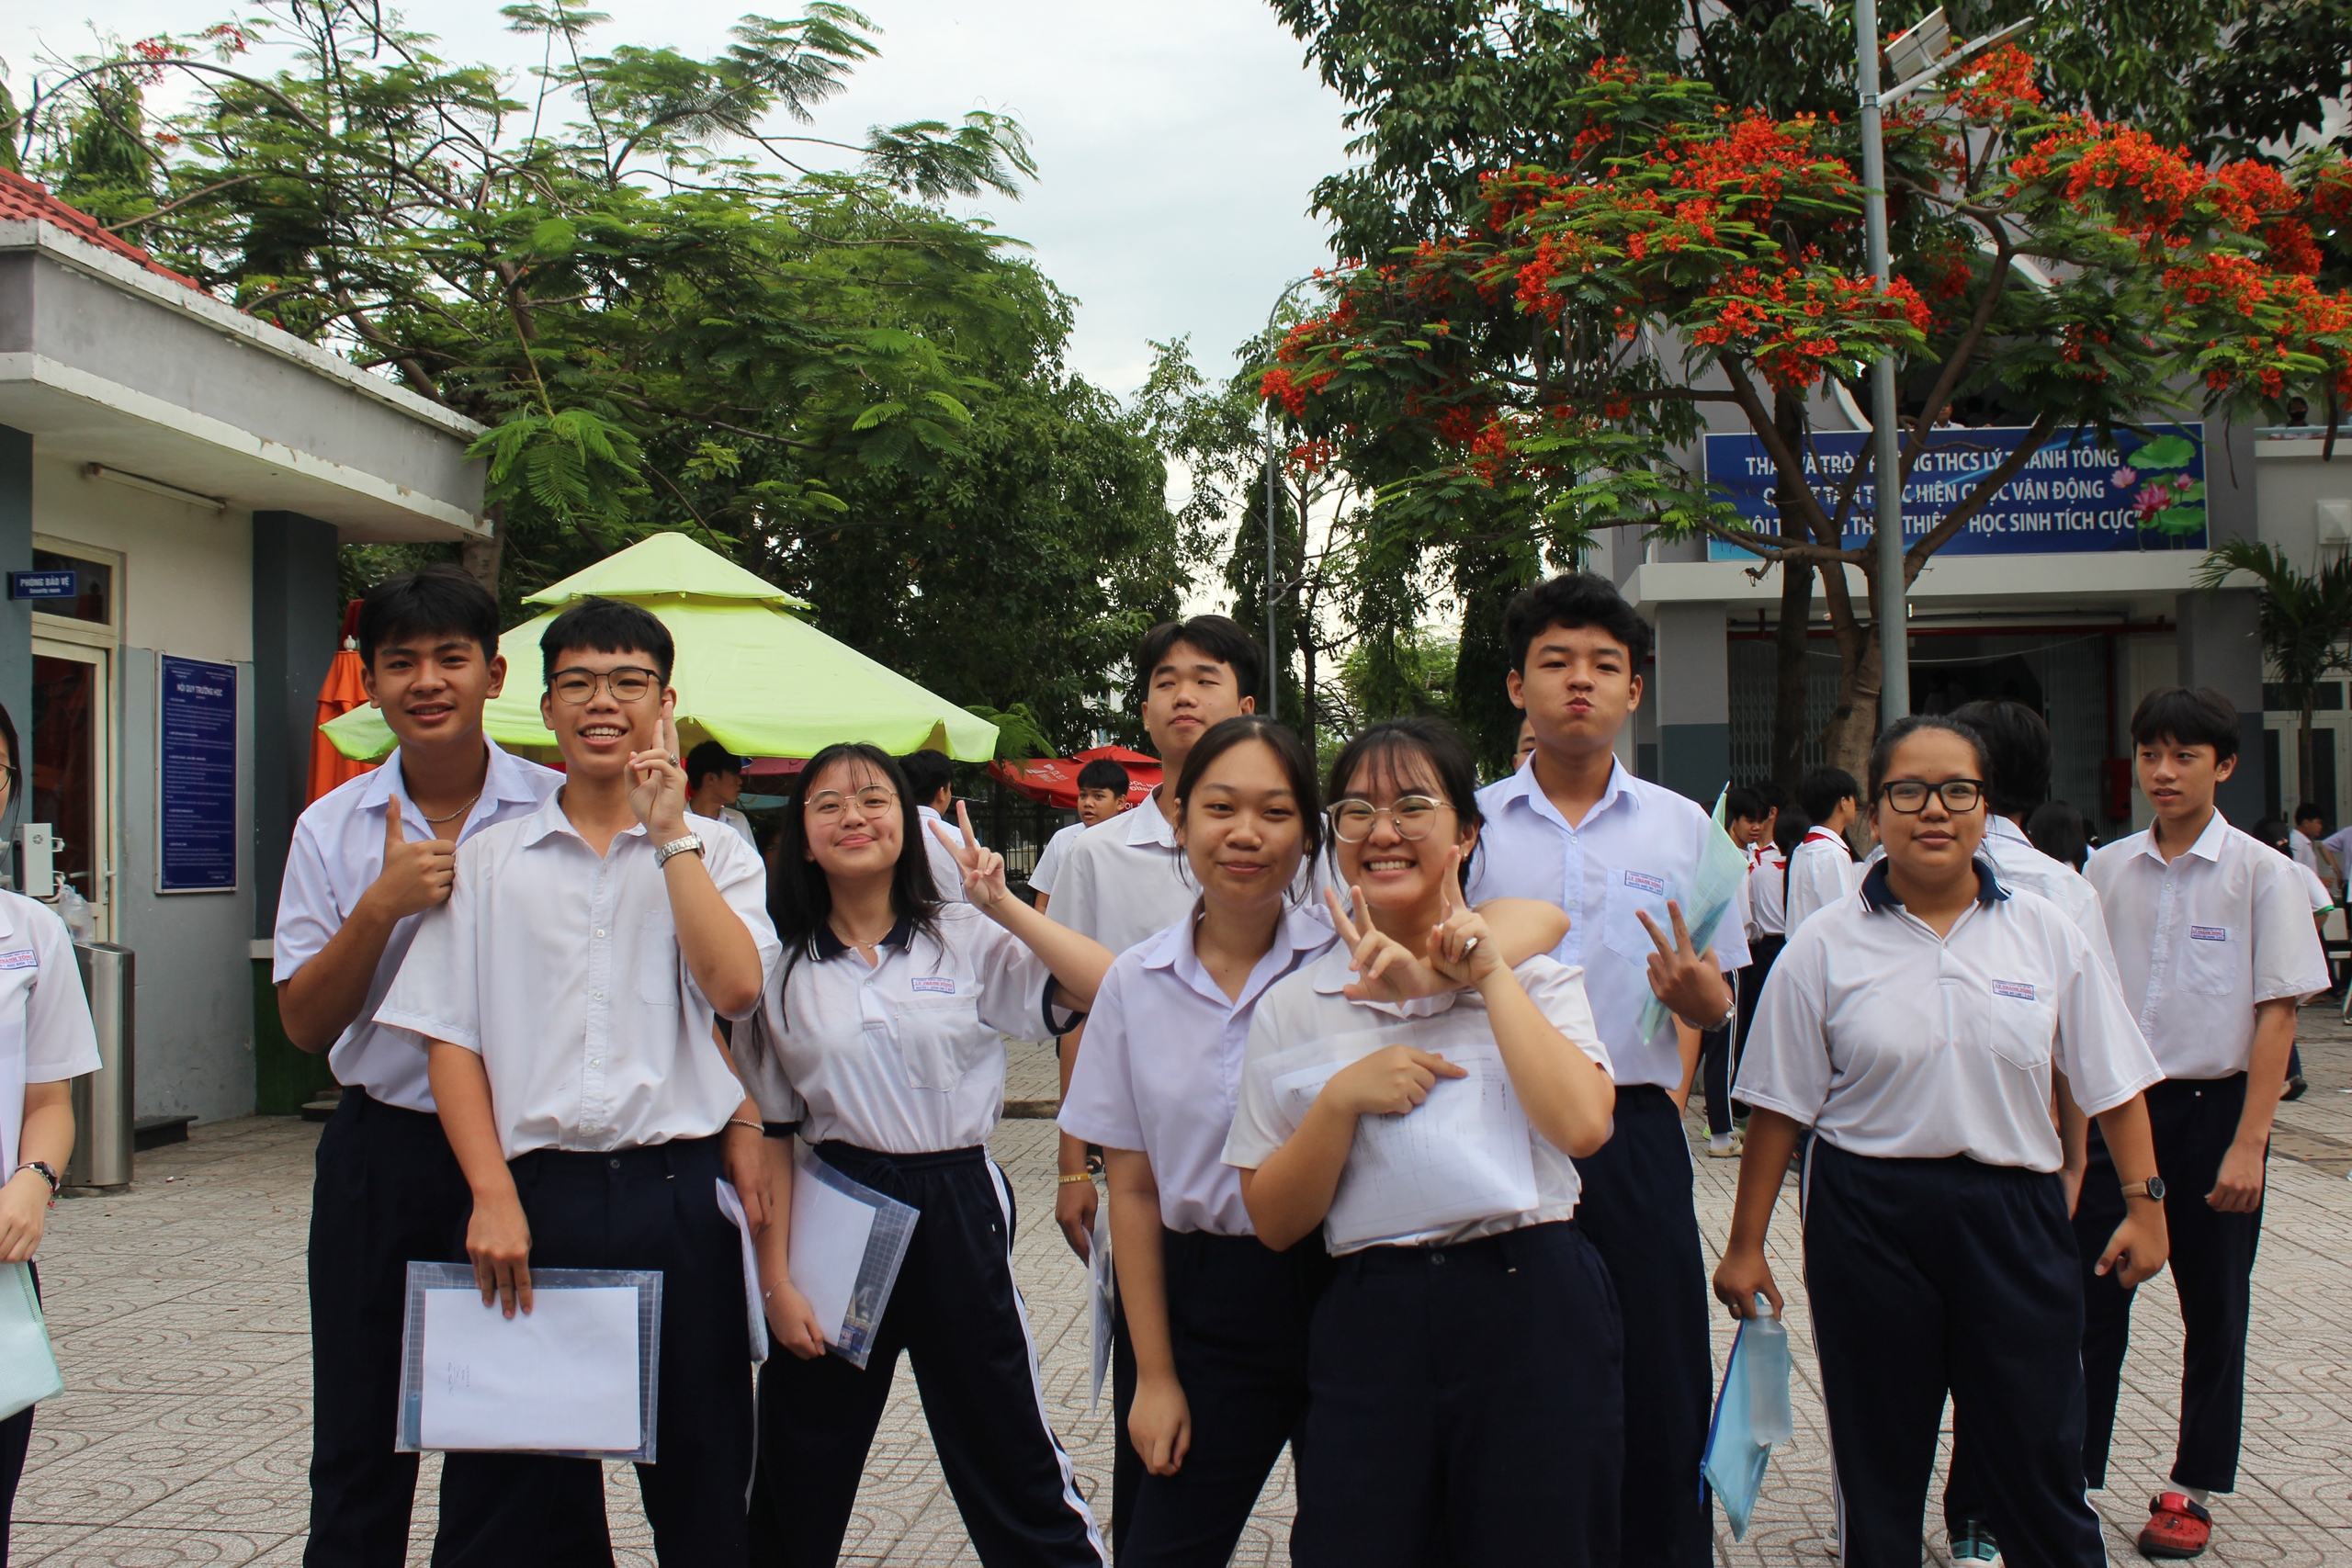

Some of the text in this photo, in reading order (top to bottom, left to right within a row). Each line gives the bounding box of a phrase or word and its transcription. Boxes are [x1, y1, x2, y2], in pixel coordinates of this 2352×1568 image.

[1819, 451, 1856, 474] TRÒ
[1935, 451, 1980, 471] THCS
[1984, 447, 2003, 470] LÝ
[2072, 446, 2120, 468] TÔNG
[1916, 480, 1957, 507] HIỆN
[2012, 478, 2049, 505] VẬN
[2052, 477, 2105, 504] ĐỘNG
[1969, 513, 2006, 537] HỌC
[2009, 513, 2052, 532] SINH
[2054, 508, 2095, 531] TÍCH
